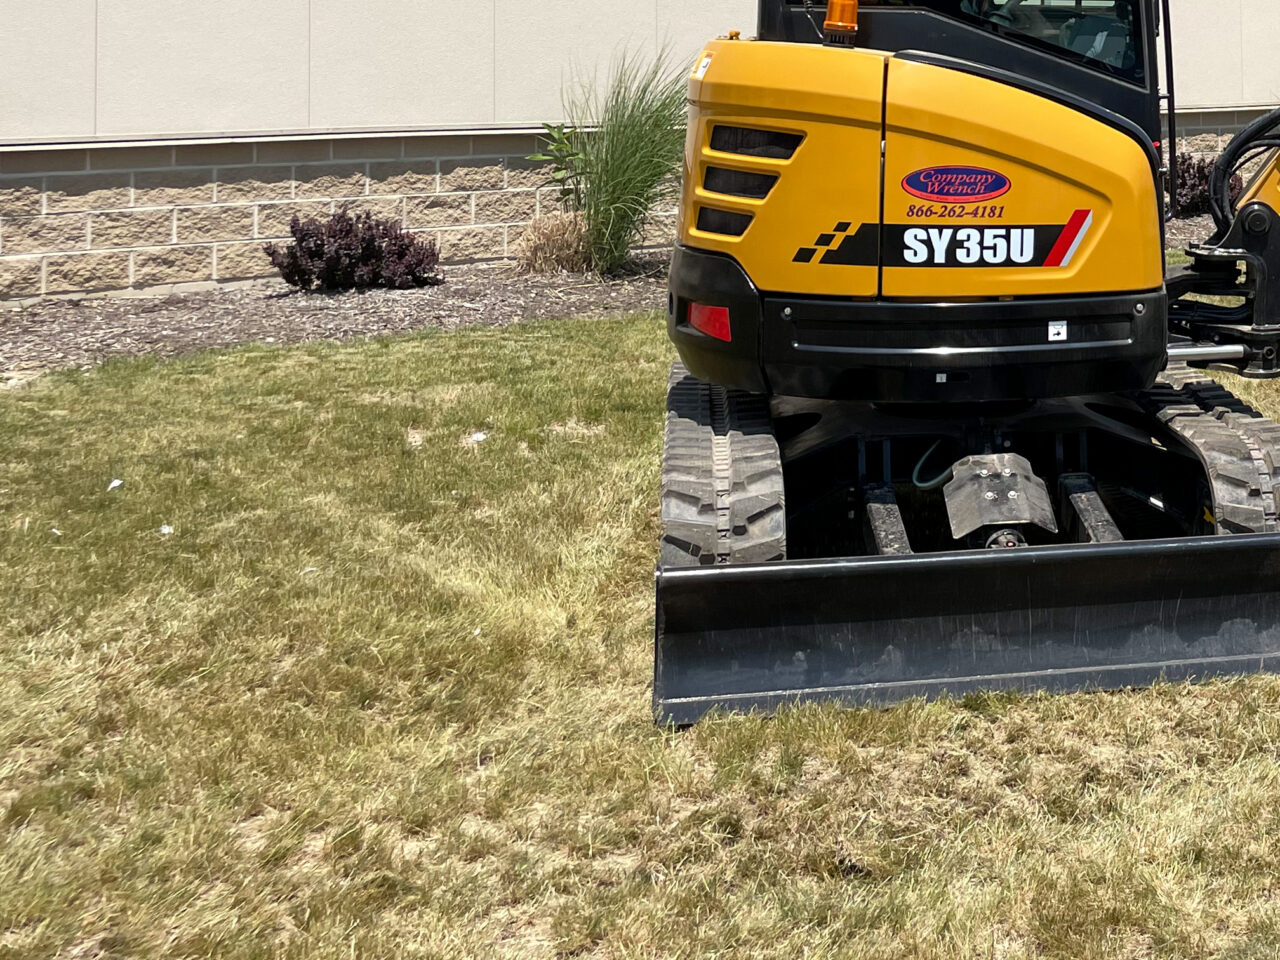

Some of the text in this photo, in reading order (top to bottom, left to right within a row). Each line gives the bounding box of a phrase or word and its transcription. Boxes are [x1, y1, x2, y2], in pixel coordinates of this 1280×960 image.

[919, 170, 996, 186] Company
[926, 181, 986, 194] Wrench
[906, 204, 1005, 218] 866-262-4181
[903, 227, 1035, 264] SY35U
